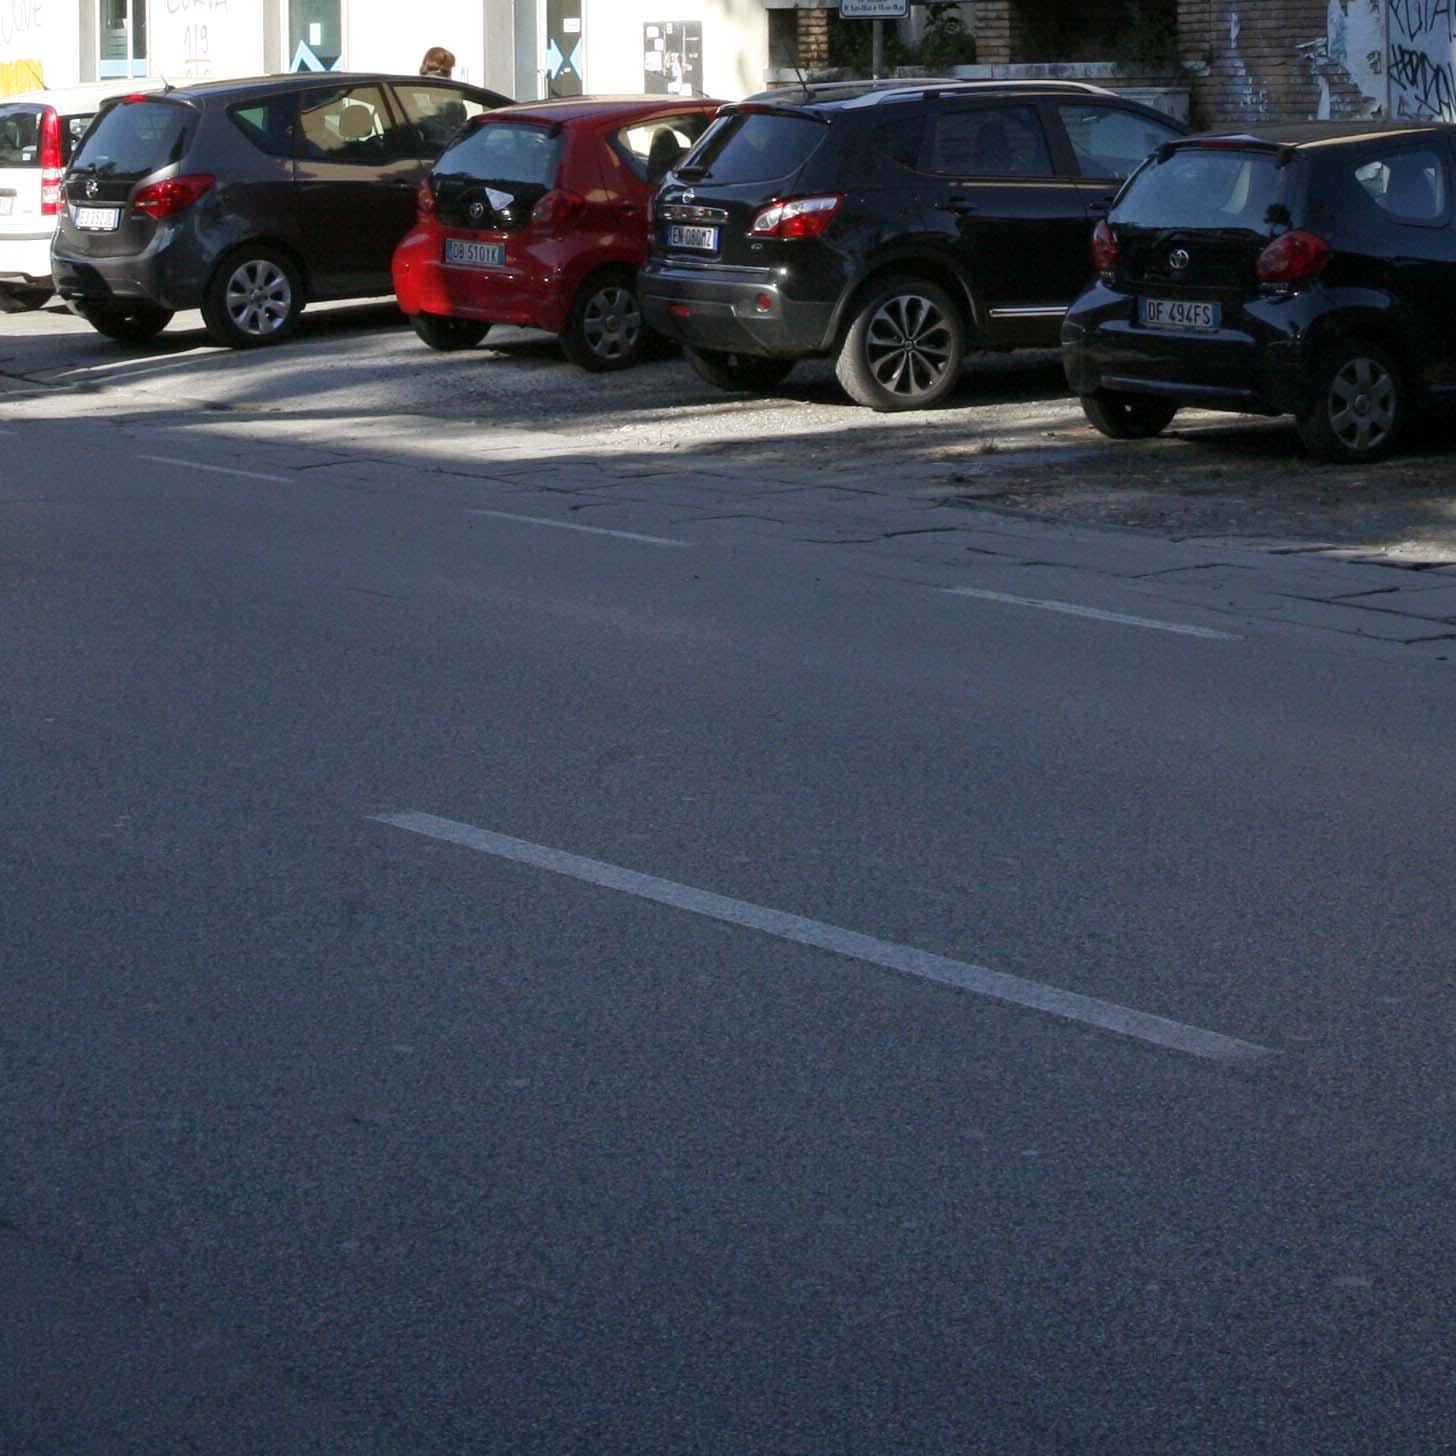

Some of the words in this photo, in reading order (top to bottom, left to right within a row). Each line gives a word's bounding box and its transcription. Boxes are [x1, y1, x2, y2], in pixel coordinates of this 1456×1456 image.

[467, 244, 498, 262] 510YK
[1148, 301, 1164, 321] DF
[1168, 302, 1211, 325] 494FS
